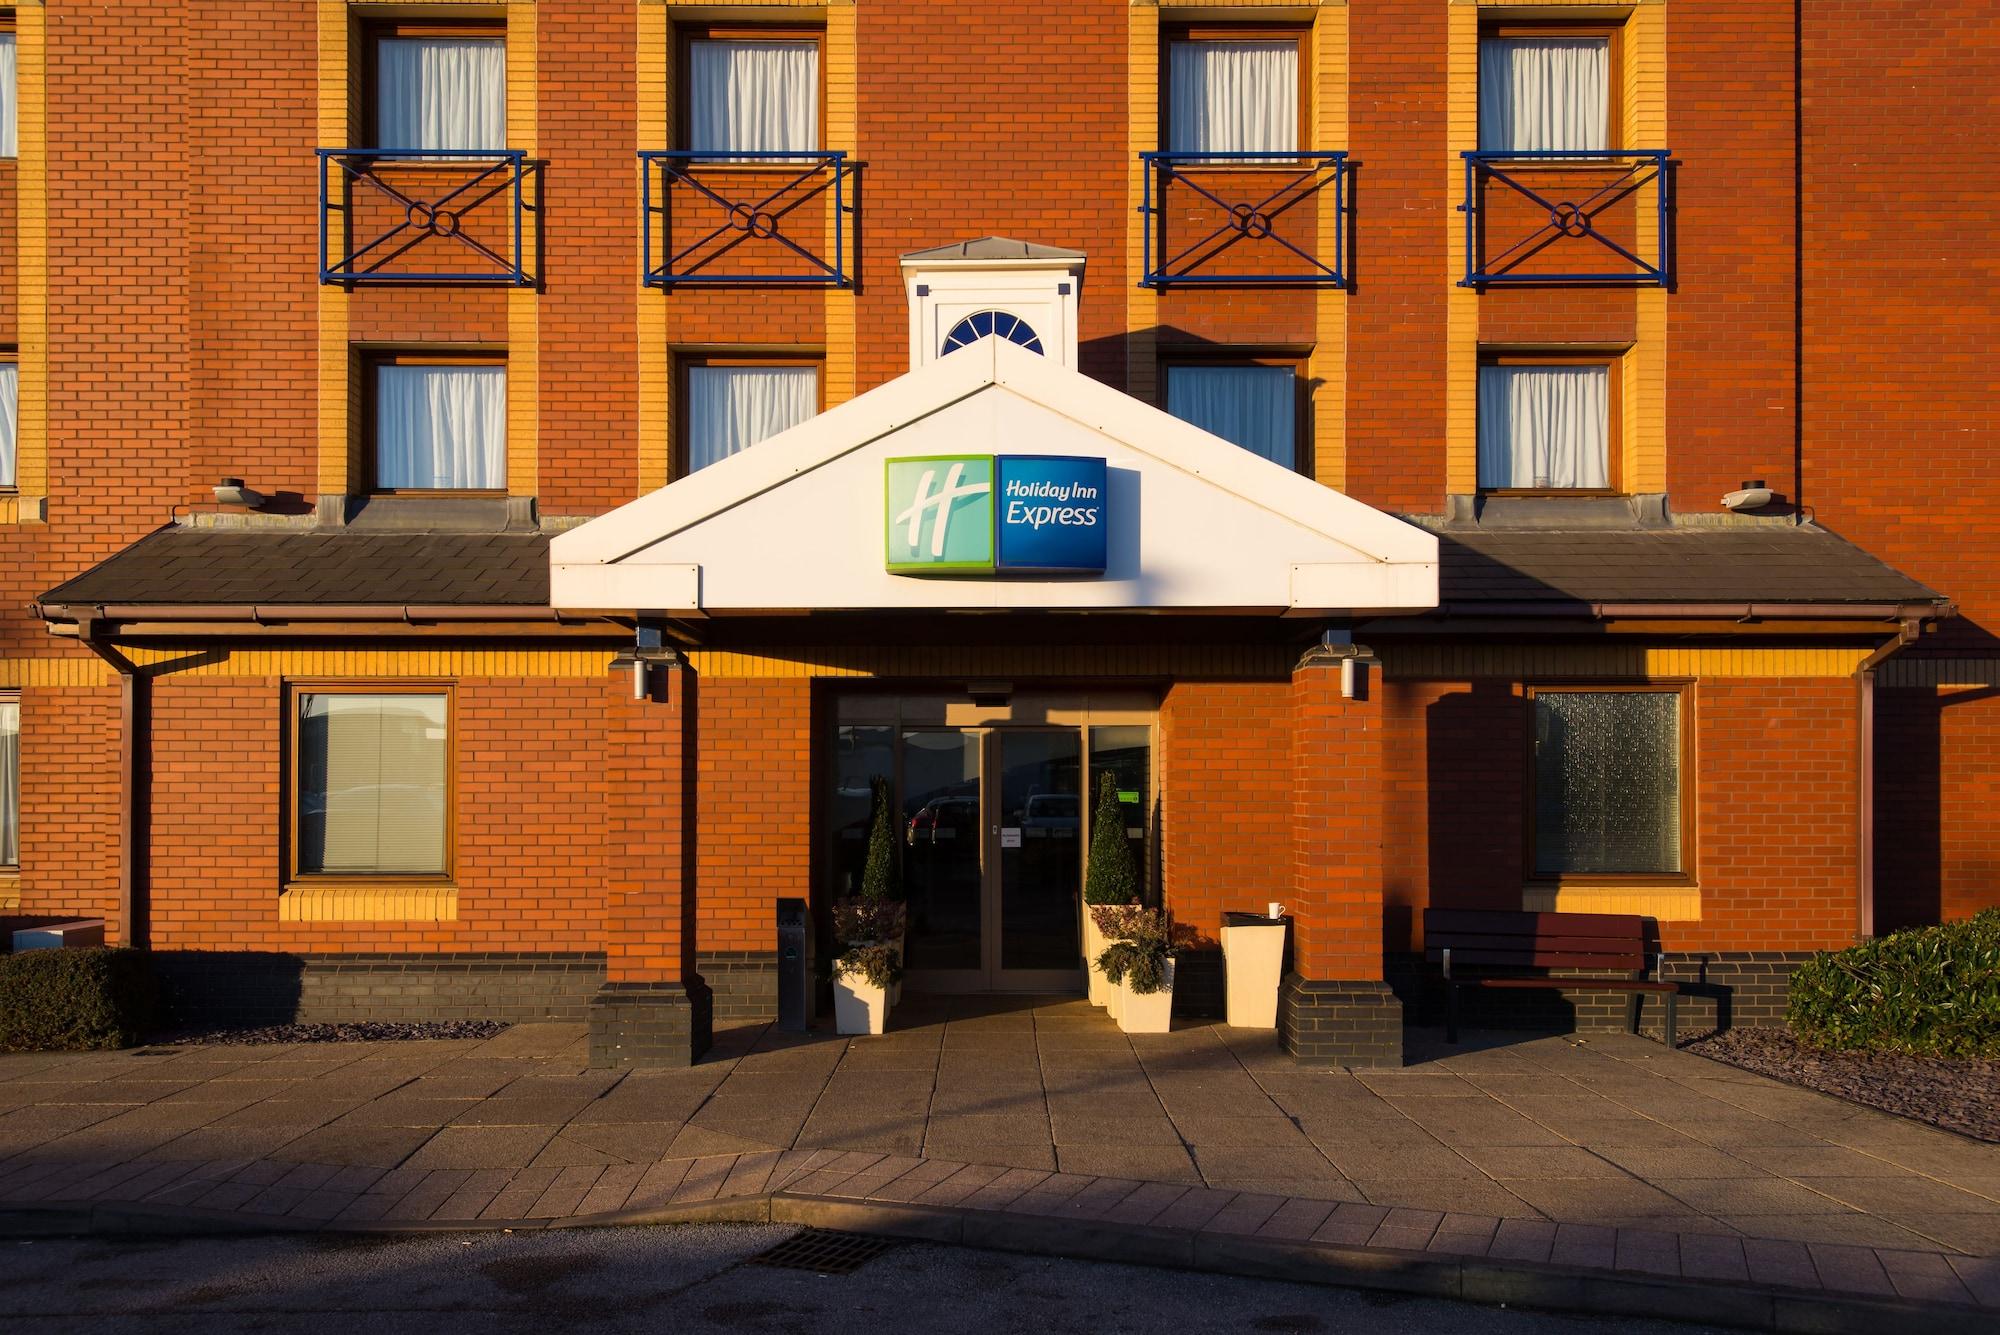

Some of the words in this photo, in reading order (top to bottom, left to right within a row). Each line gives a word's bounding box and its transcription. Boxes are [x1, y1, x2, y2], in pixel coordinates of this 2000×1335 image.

[1006, 480, 1070, 501] Holiday
[1072, 482, 1097, 499] Inn
[1007, 501, 1097, 530] Express
